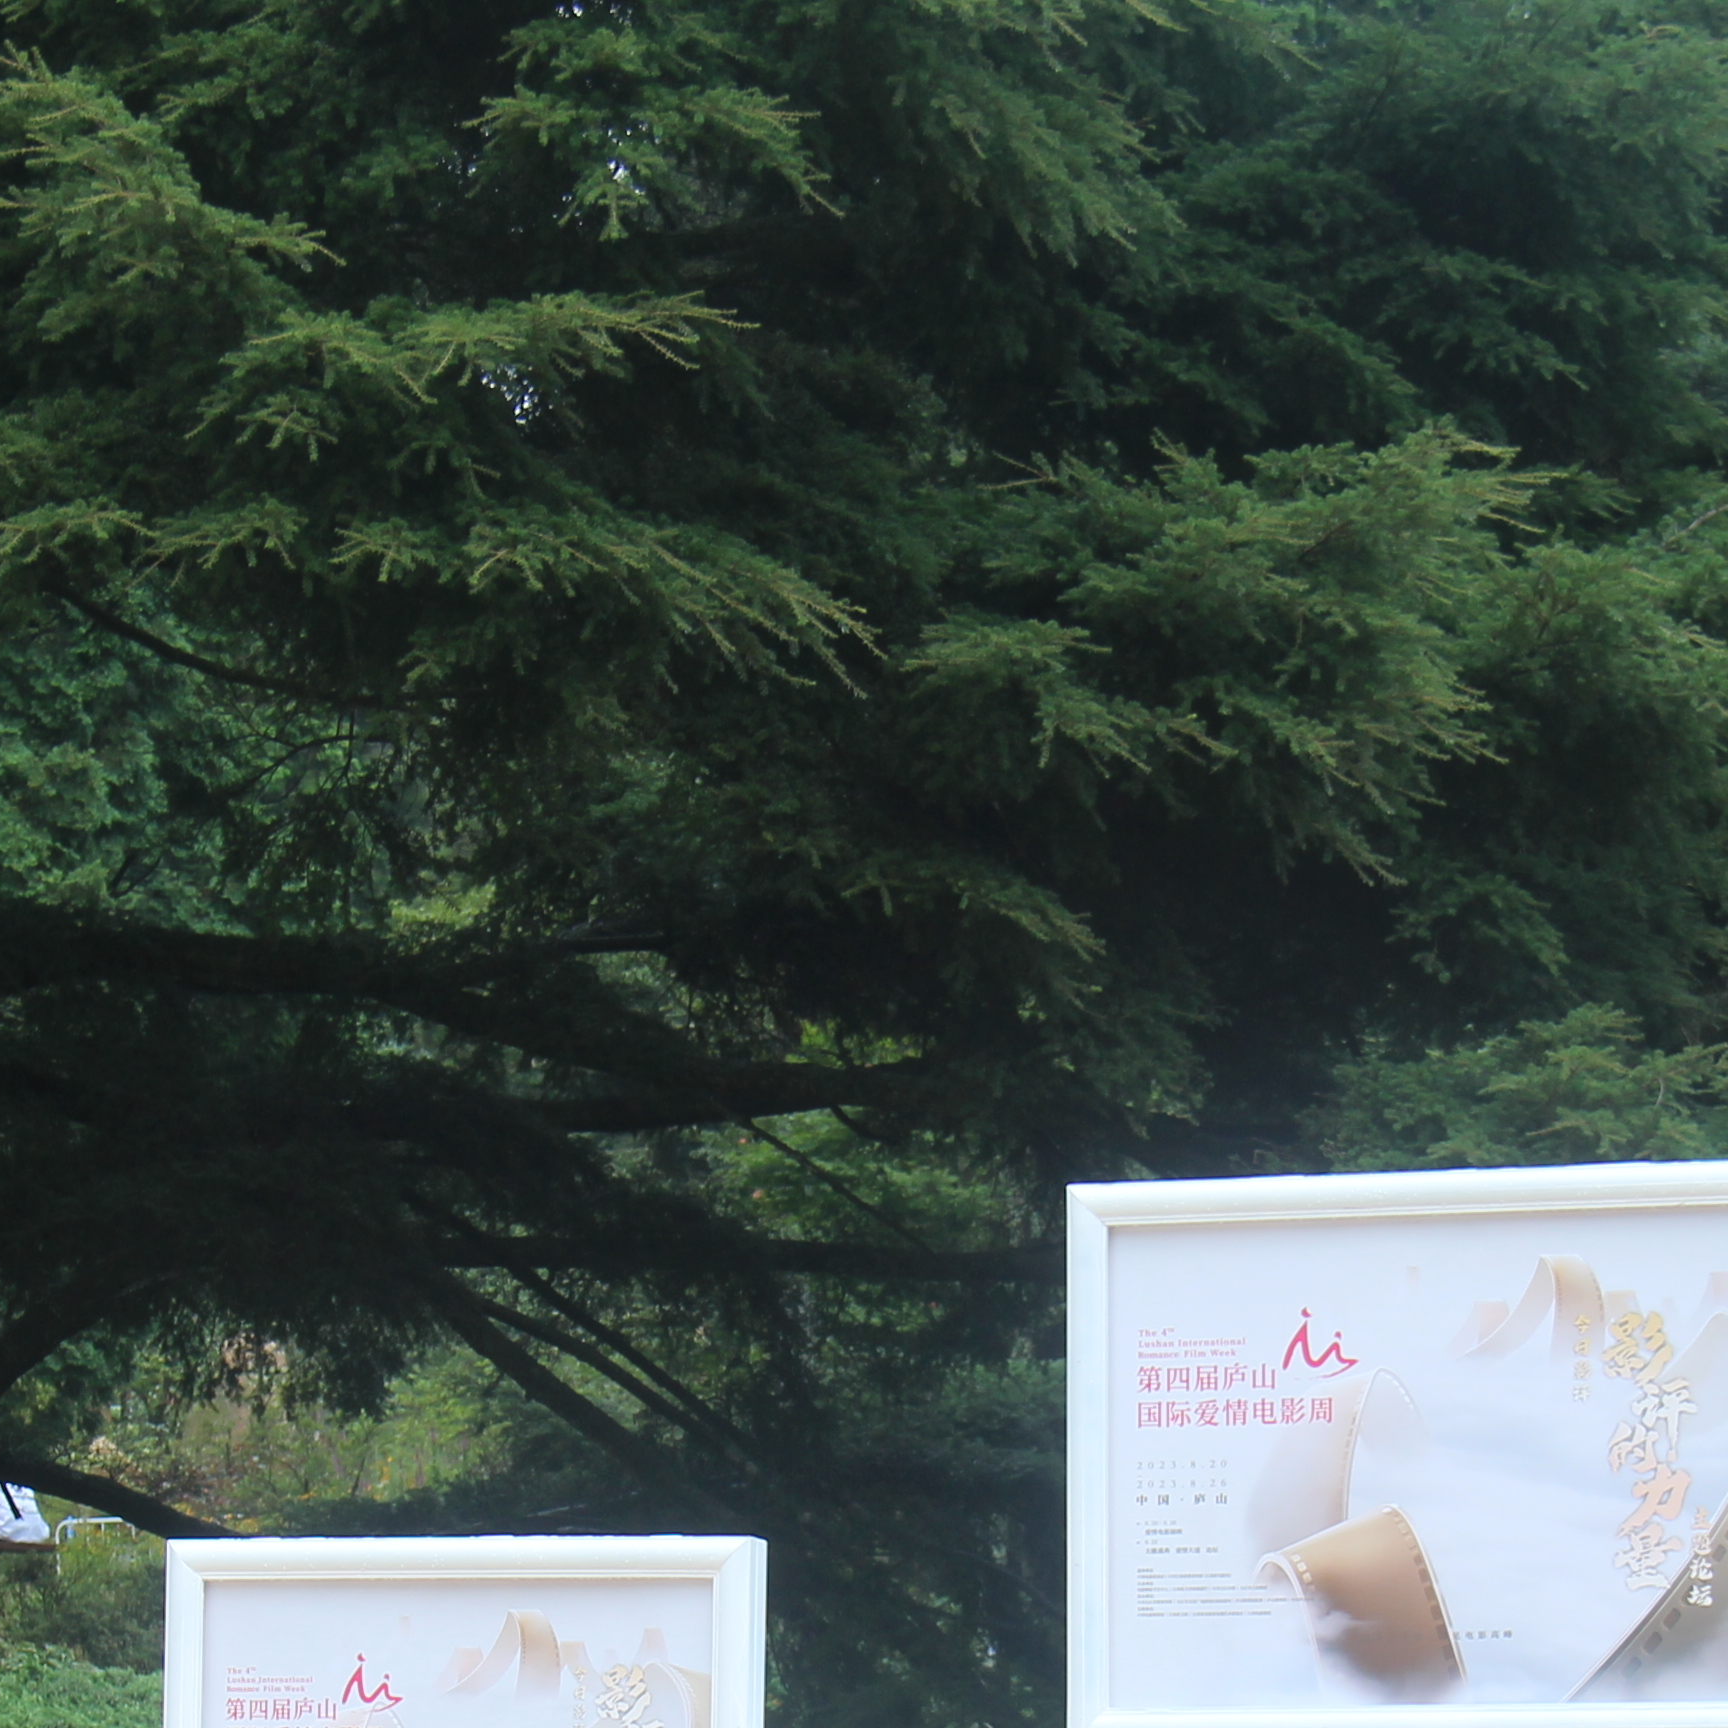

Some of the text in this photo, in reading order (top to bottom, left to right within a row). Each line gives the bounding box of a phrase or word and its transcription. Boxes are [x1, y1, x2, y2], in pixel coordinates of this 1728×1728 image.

[1138, 1329, 1157, 1337] The
[1138, 1337, 1246, 1349] Lushan International
[1137, 1349, 1236, 1359] Romance Film Week
[1136, 1362, 1276, 1393] 第四届庐山
[1137, 1397, 1333, 1428] 国际爱情电影周
[1601, 1311, 1699, 1592] 影评的力量
[1687, 1506, 1714, 1606] 主题论坛
[226, 1676, 314, 1684] Lushan International
[225, 1696, 337, 1721] 第四届庐山
